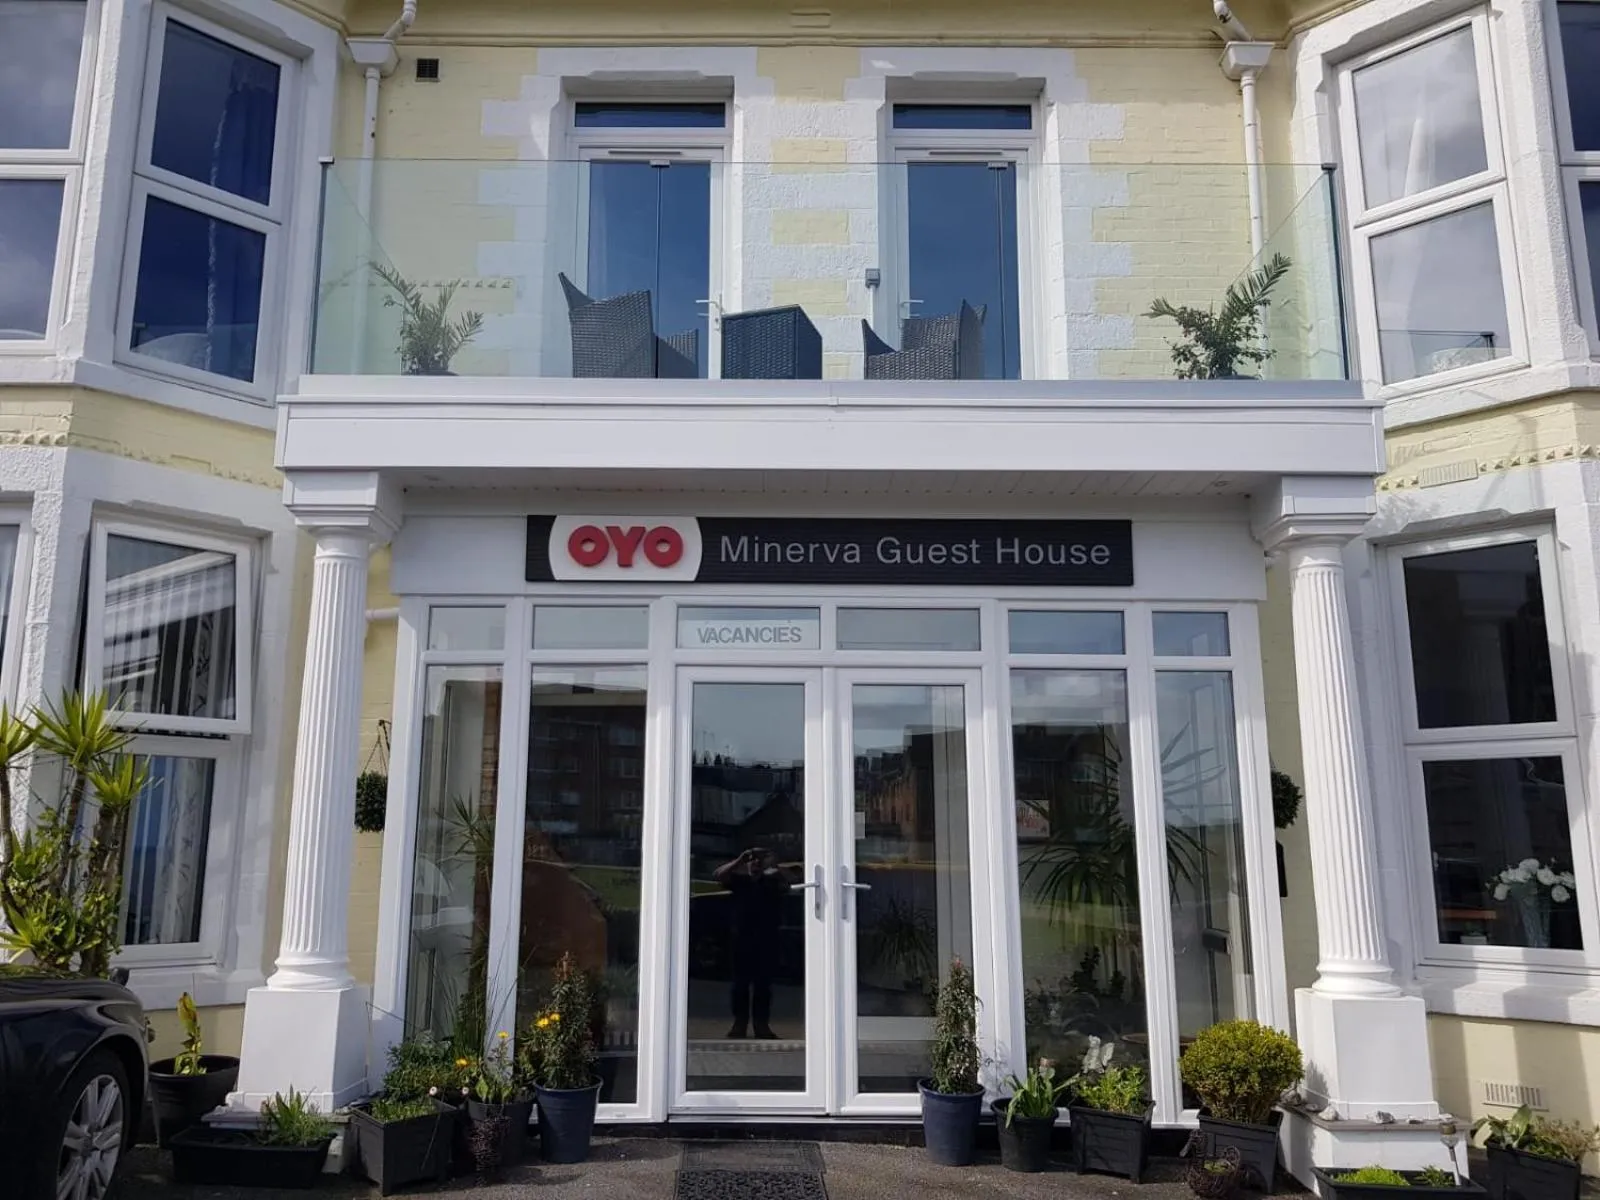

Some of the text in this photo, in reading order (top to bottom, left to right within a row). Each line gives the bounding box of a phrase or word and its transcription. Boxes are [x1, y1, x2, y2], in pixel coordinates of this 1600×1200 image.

[568, 525, 684, 568] OYO
[719, 535, 1111, 565] Minerva Guest House
[697, 626, 803, 644] VACANCIES
